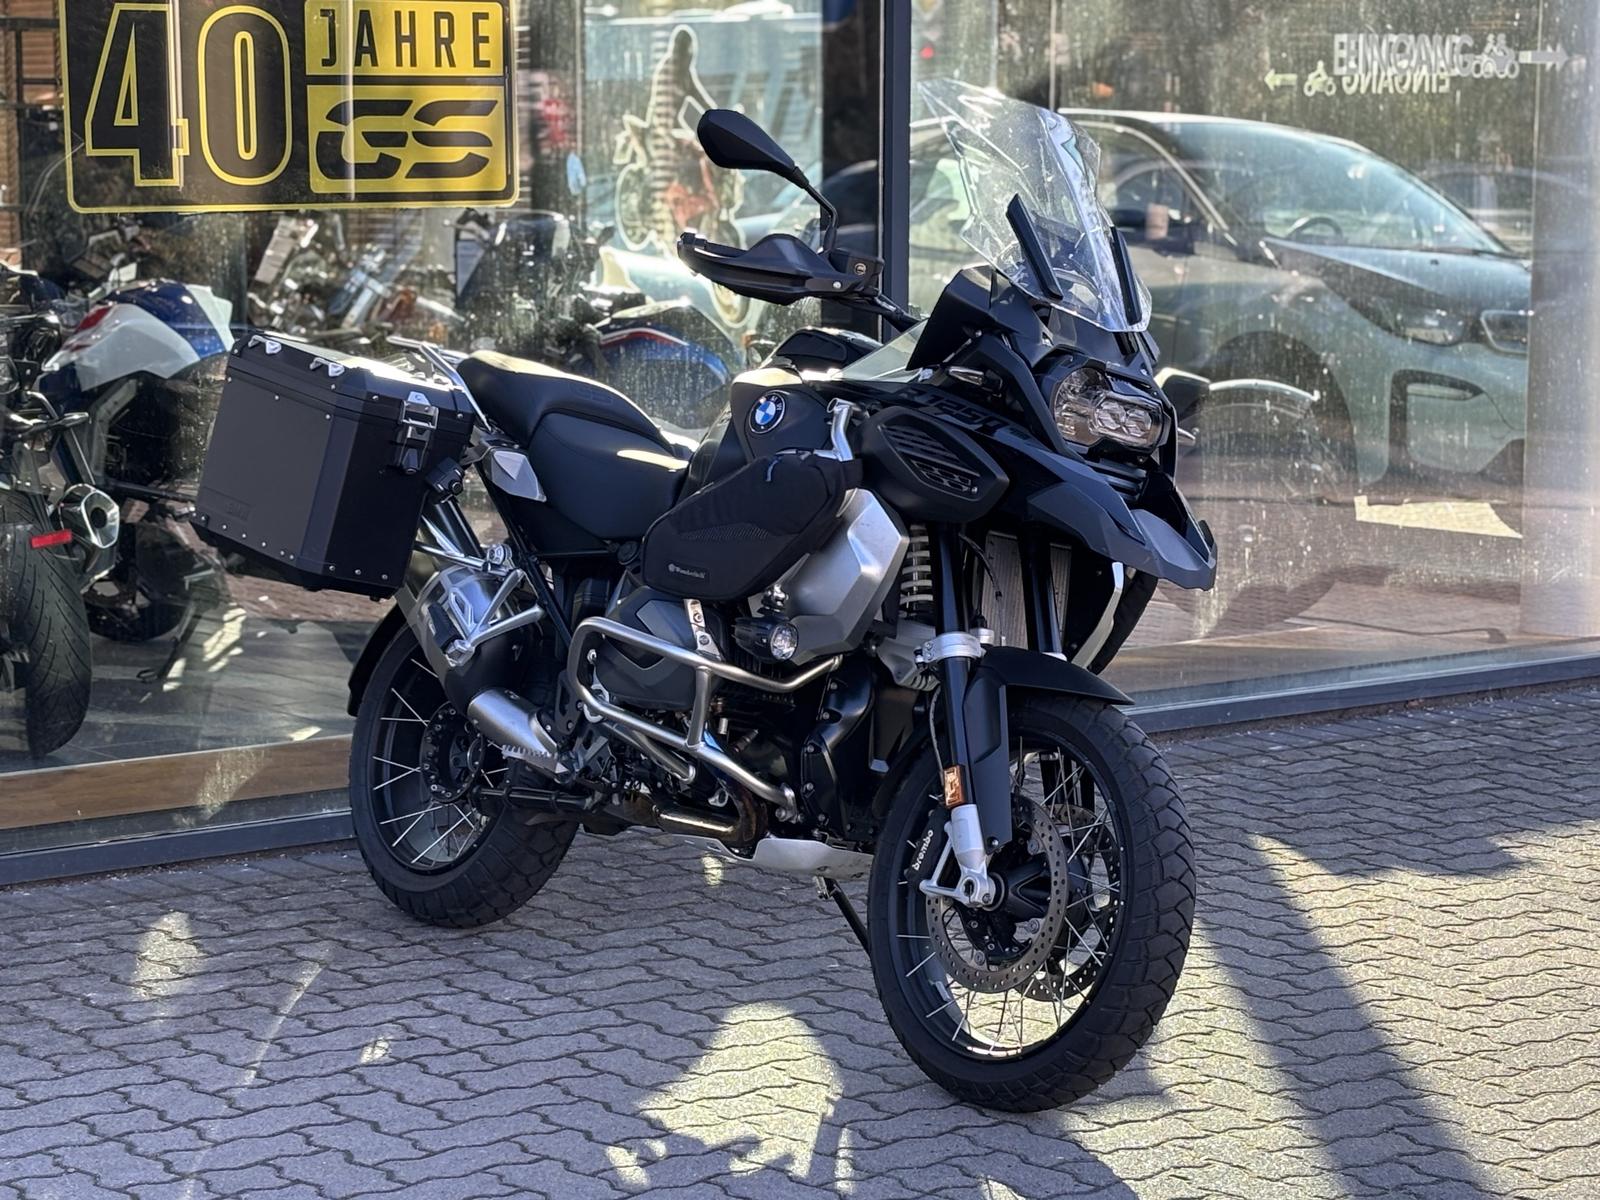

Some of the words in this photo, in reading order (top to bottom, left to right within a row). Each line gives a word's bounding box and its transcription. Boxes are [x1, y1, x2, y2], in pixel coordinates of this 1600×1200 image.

[319, 8, 492, 68] JAHRE
[84, 2, 293, 187] 40
[315, 99, 499, 180] GS
[911, 829, 934, 871] brembo
